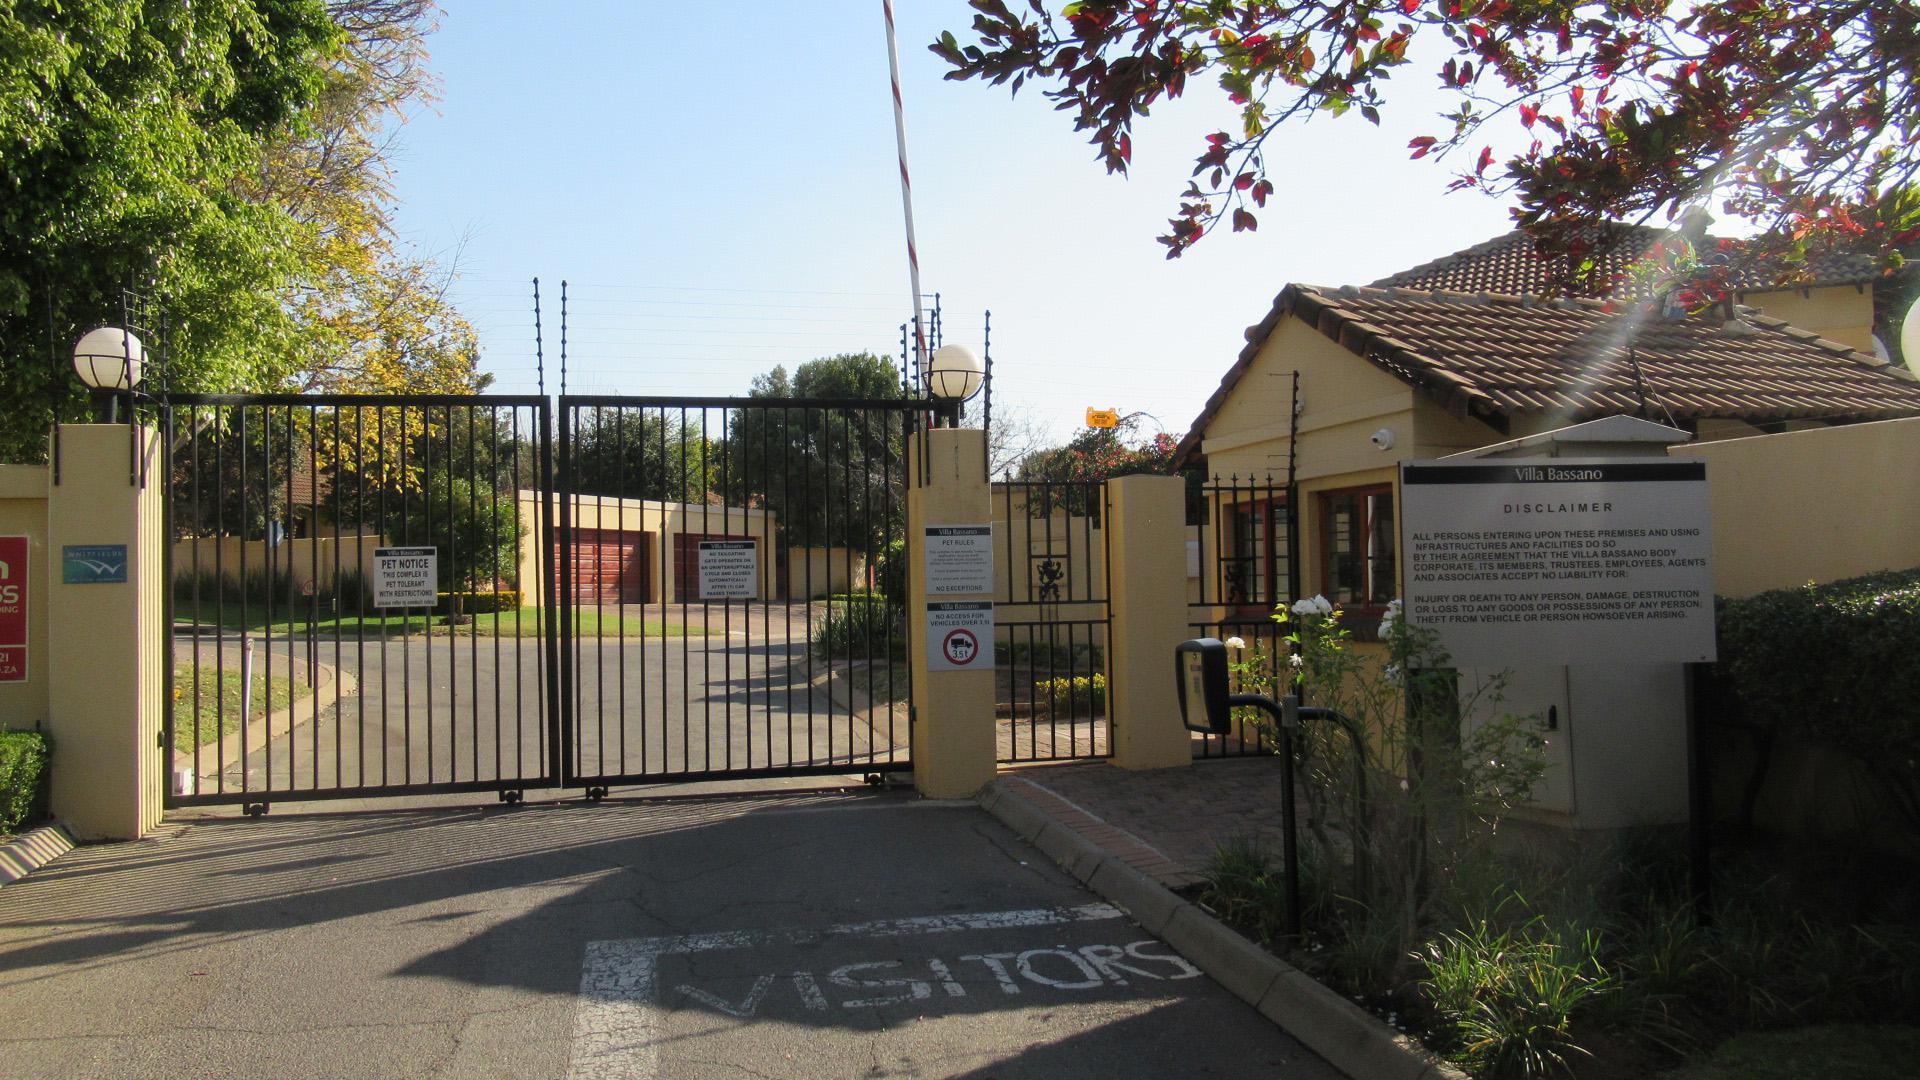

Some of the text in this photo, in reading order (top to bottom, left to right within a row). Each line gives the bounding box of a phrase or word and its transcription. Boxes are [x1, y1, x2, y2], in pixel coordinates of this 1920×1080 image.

[1515, 467, 1603, 481] Villa Bassano
[1504, 502, 1613, 514] DISCLAIMER
[1412, 528, 1700, 541] ALL PERSONS ENTERING UPON THESE PREMISES AND USING
[1509, 541, 1530, 550] AND
[1533, 540, 1584, 549] FACILITIES
[1586, 540, 1600, 549] DO
[1602, 540, 1616, 548] SO
[1414, 549, 1677, 561] BY THEIR AGREEMENT THAT THE VILLA BASSANO BODY
[381, 558, 429, 569] PET NOTICE
[1479, 562, 1495, 571] ITS
[1668, 558, 1706, 567] AGENTS
[1414, 573, 1435, 582] AND
[1437, 572, 1499, 582] ASSOCIATES
[1500, 572, 1539, 581] ACCEPT
[1542, 571, 1556, 580] NO
[1558, 570, 1603, 579] LIABILITY
[397, 580, 425, 588] TOLERANT
[379, 589, 433, 598] WITH RESTRICTIONS
[1414, 594, 1450, 603] INJURY
[1453, 593, 1467, 603] OR
[1469, 593, 1501, 602] DEATH
[1503, 593, 1517, 602] TO
[1519, 593, 1539, 601] ANY
[1633, 590, 1699, 599] DESTRUCTION
[1415, 605, 1430, 614] OR
[1432, 604, 1458, 613] LOSS
[1461, 604, 1475, 613] TO
[1476, 604, 1497, 613] ANY
[1499, 603, 1534, 612] GOODS
[1536, 603, 1551, 611] OR
[1553, 602, 1621, 611] POSSESSIONS
[1623, 601, 1636, 609] OF
[1638, 601, 1658, 610] ANY
[1416, 615, 1447, 624] THEFT
[1449, 615, 1478, 623] FROM
[1479, 614, 1521, 623] VEHICLE
[1523, 613, 1538, 622] OR
[1540, 613, 1580, 621] PERSON
[1582, 612, 1644, 620] HOWSOEVER
[674, 940, 1204, 1017] VISITORS
